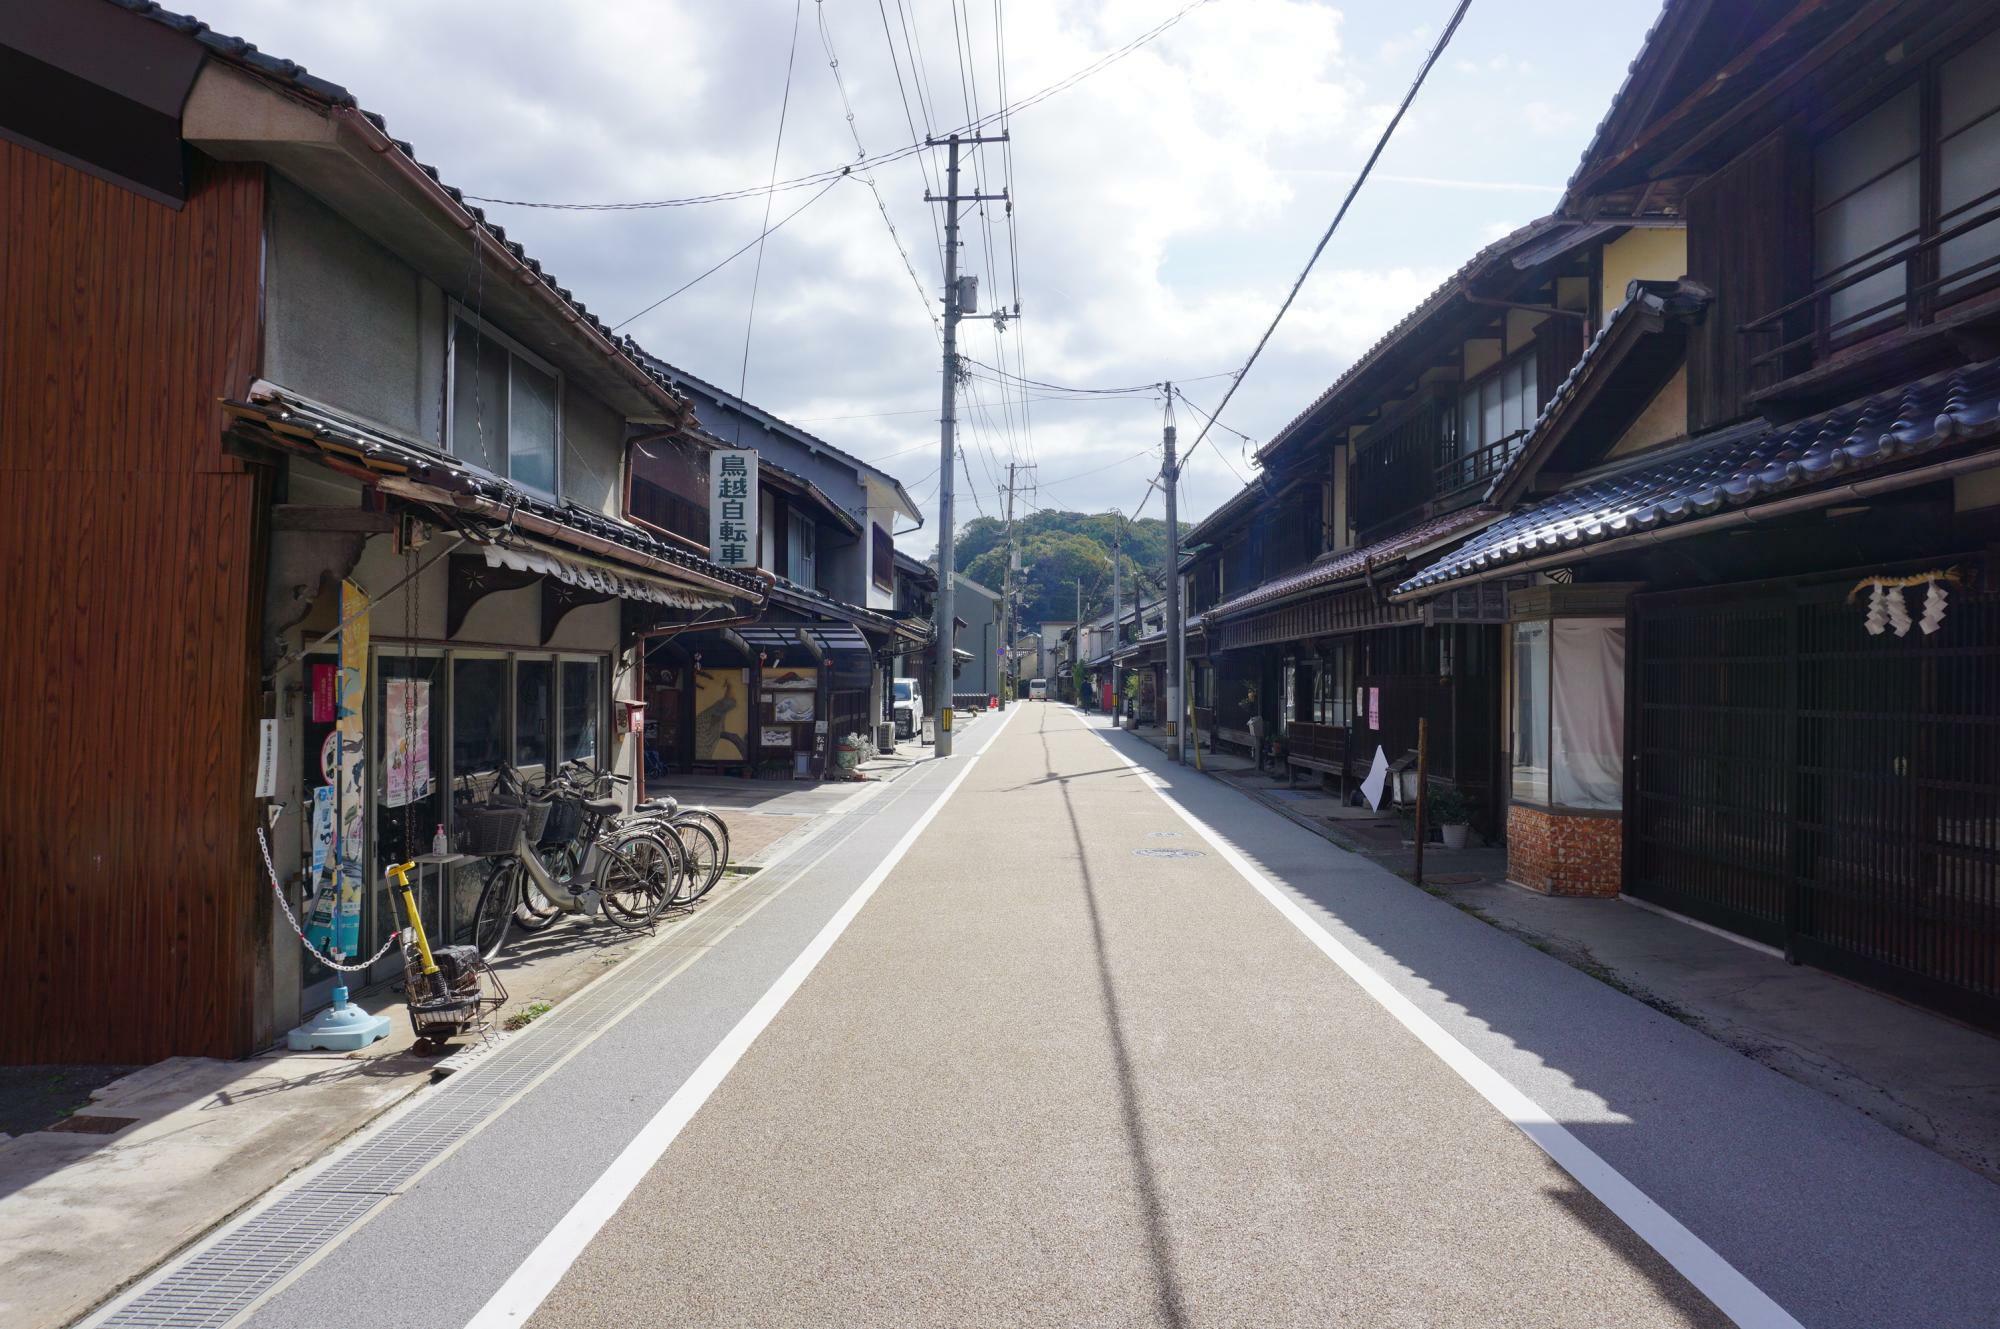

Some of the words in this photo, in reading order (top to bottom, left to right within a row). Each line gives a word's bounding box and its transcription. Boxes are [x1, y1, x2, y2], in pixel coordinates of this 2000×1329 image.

[718, 454, 748, 565] 鳥越自転車
